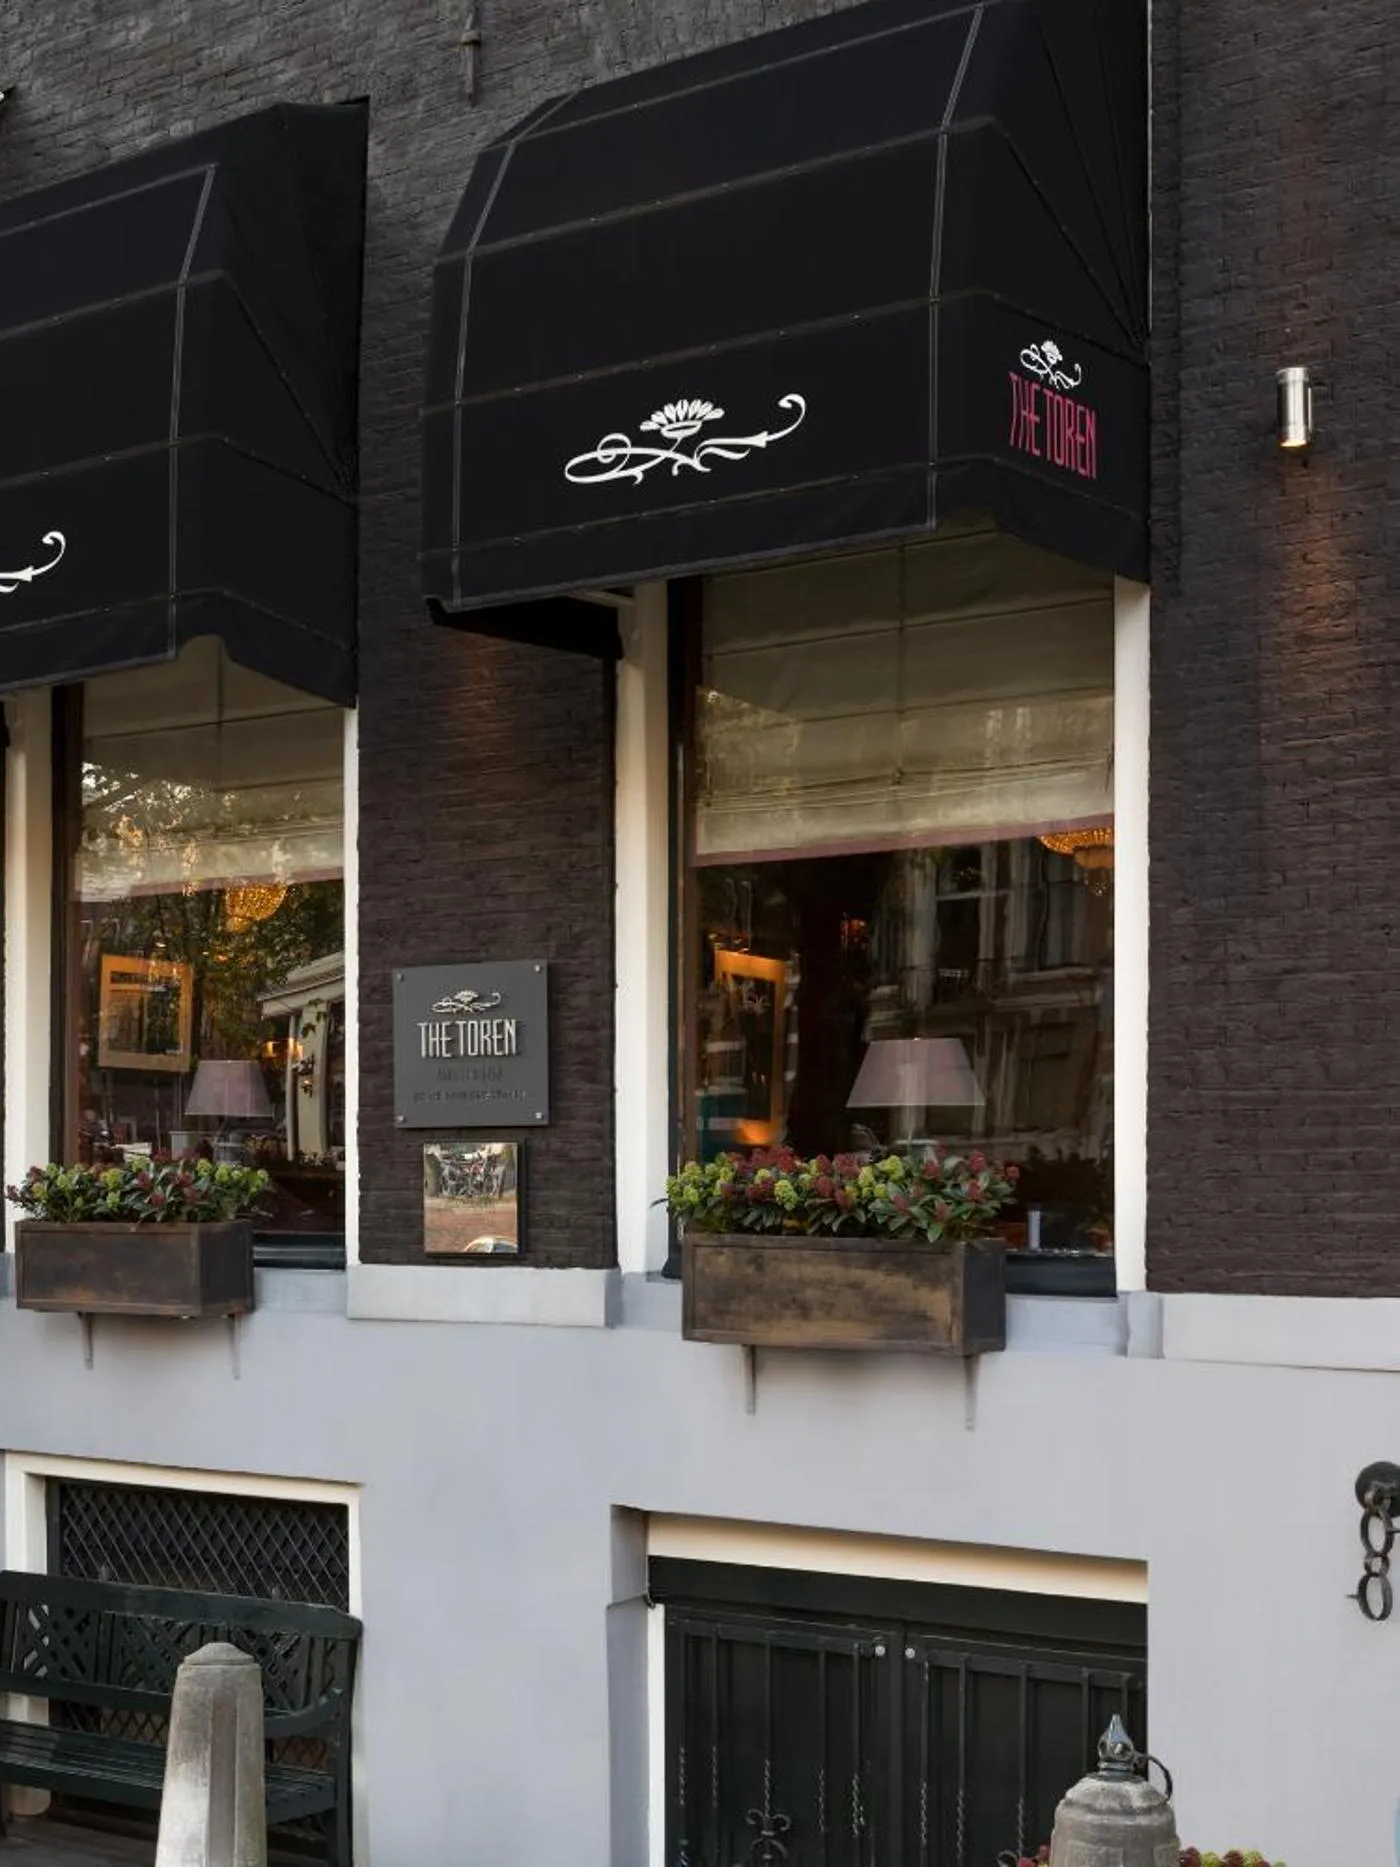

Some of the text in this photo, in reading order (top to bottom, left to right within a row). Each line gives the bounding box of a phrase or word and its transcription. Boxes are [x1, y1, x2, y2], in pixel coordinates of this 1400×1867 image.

[1008, 371, 1097, 479] THE TOREN
[416, 1018, 517, 1058] THE TOREN
